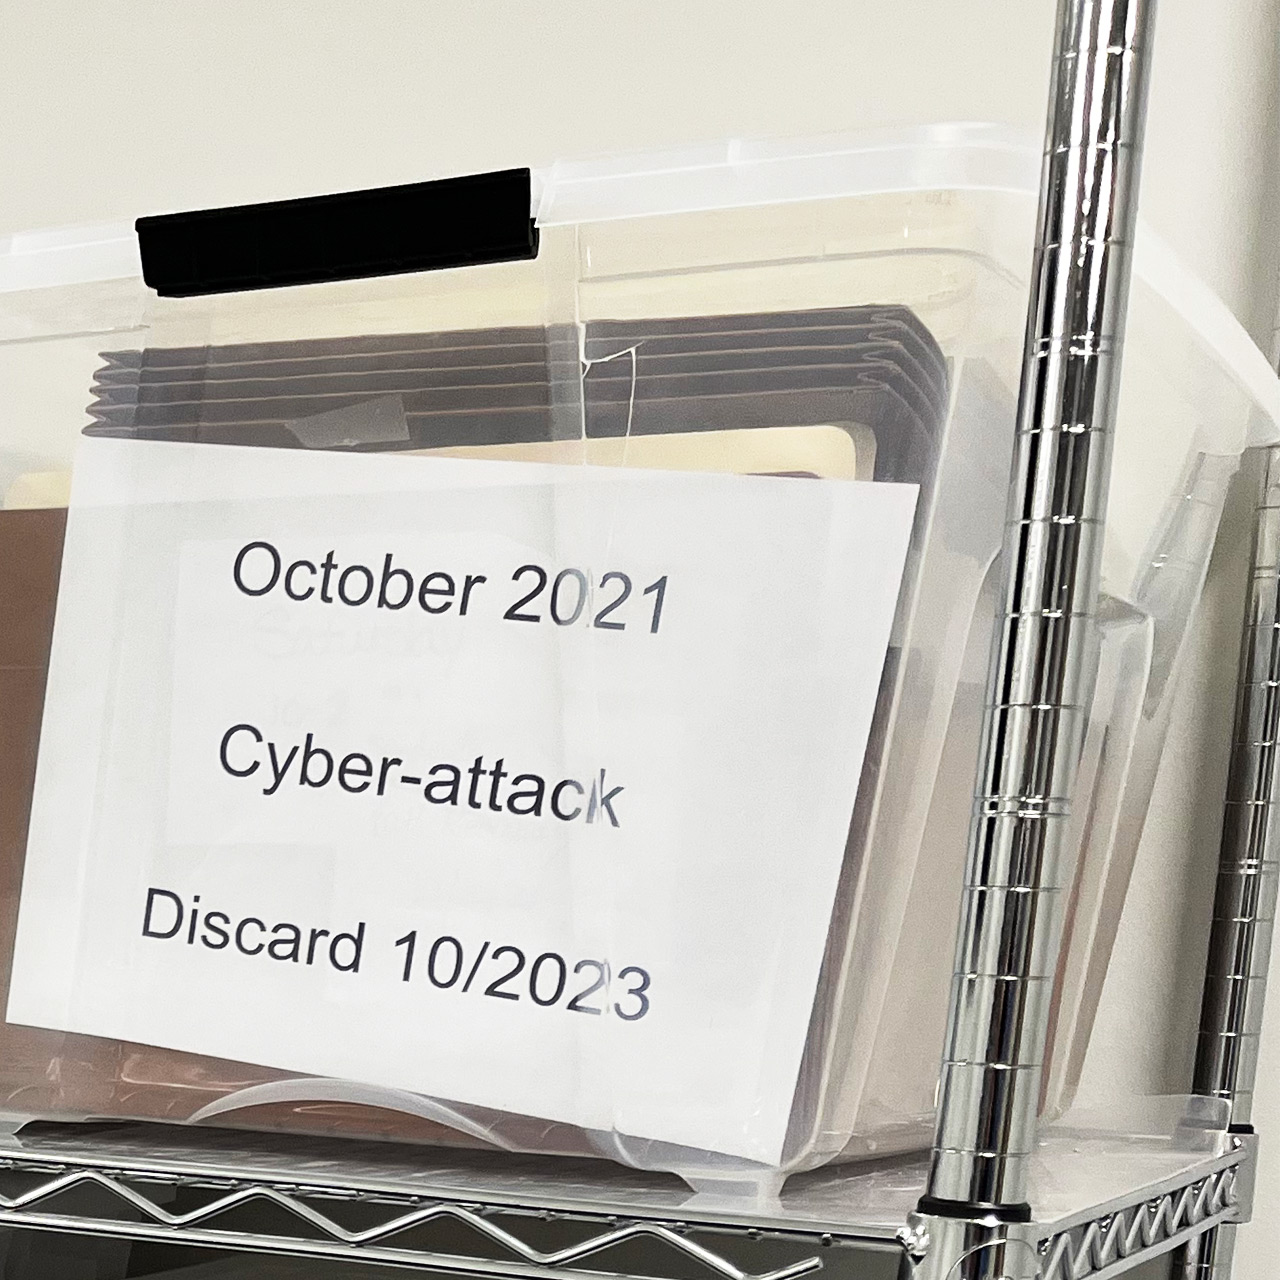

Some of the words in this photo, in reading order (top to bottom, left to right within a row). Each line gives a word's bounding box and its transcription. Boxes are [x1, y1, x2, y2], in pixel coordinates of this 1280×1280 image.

[233, 541, 486, 617] October
[503, 564, 668, 633] 2021
[219, 724, 624, 828] Cyber-attack
[142, 888, 365, 973] Discard
[394, 930, 651, 1021] 10/2023
